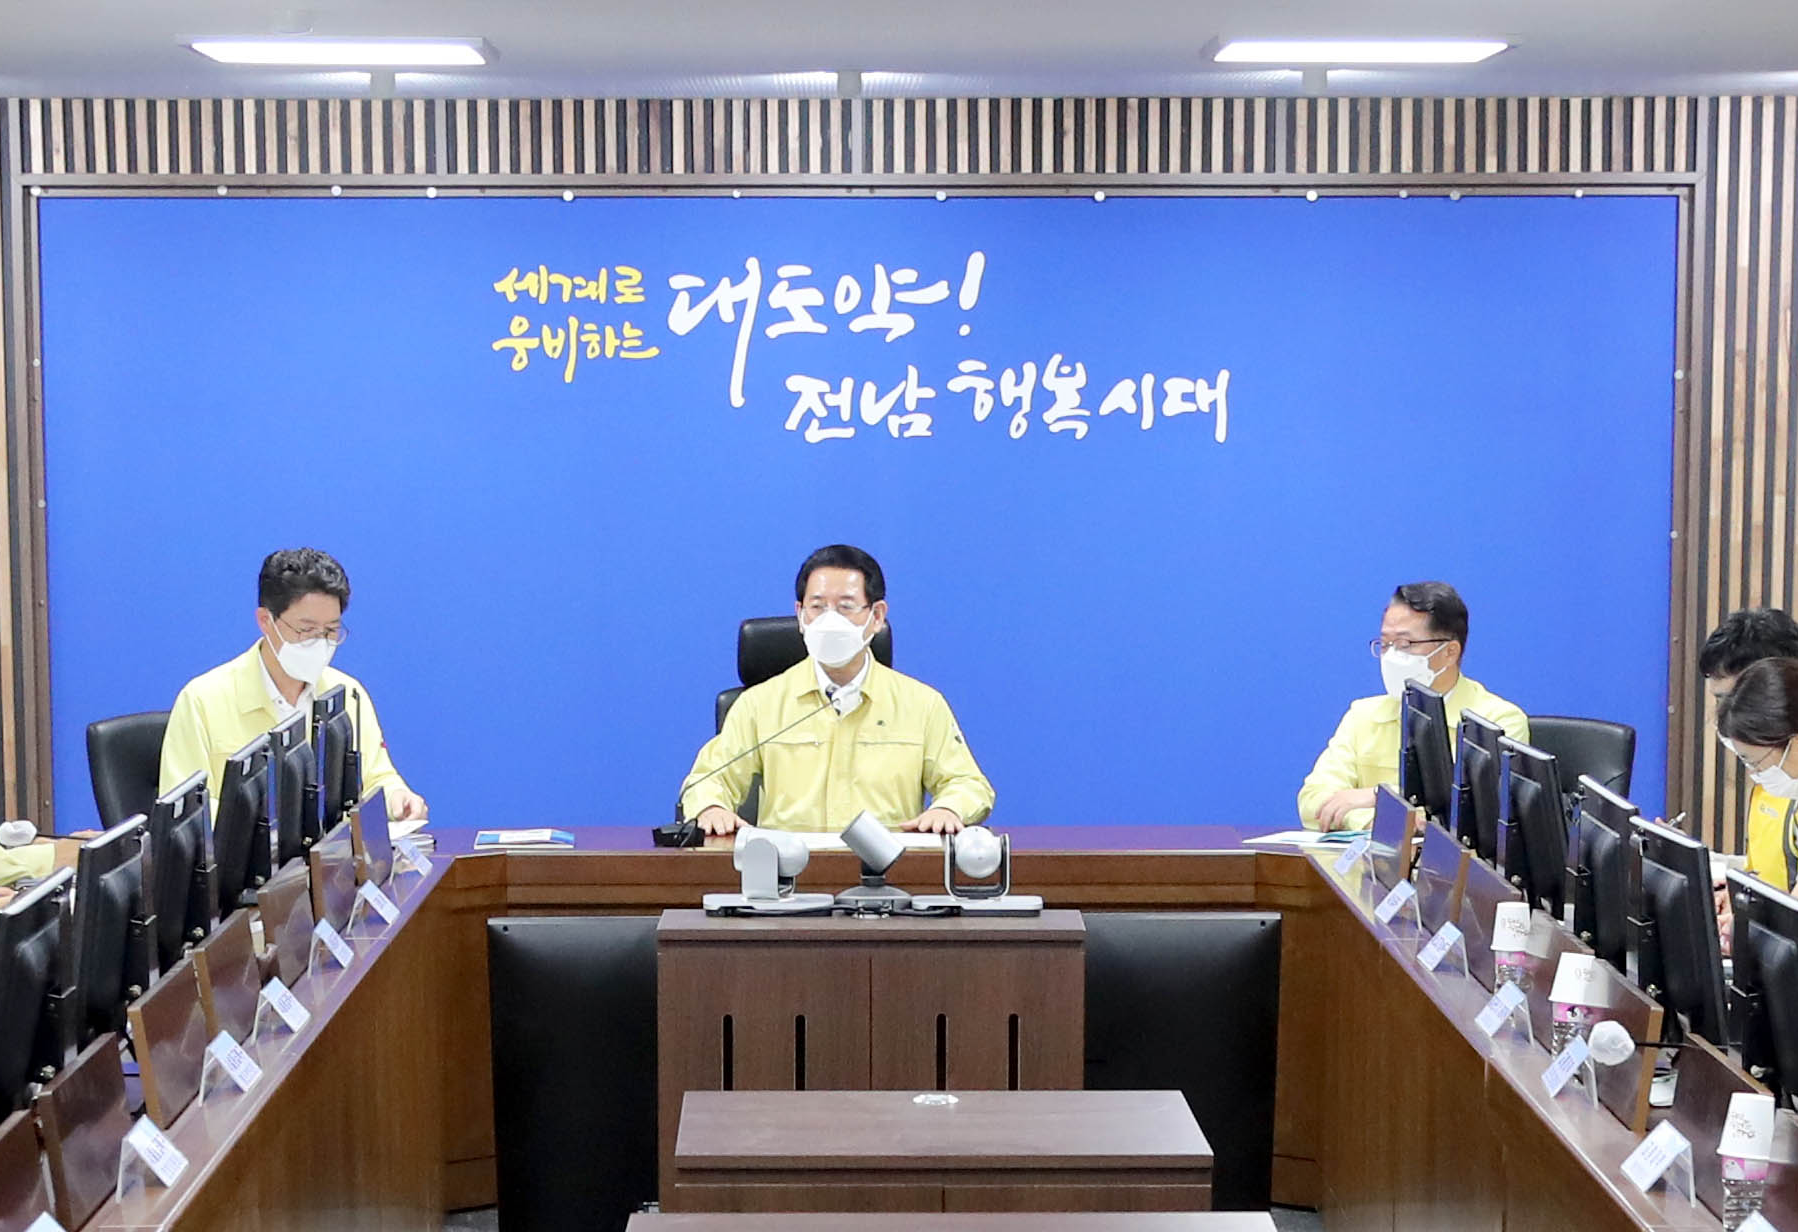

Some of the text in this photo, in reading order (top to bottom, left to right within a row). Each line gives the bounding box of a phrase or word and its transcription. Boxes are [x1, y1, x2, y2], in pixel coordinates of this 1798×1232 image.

[493, 264, 646, 305] 세계로
[491, 315, 660, 384] 웅비하는
[667, 251, 987, 408] 대도약!
[784, 364, 937, 444] 전남
